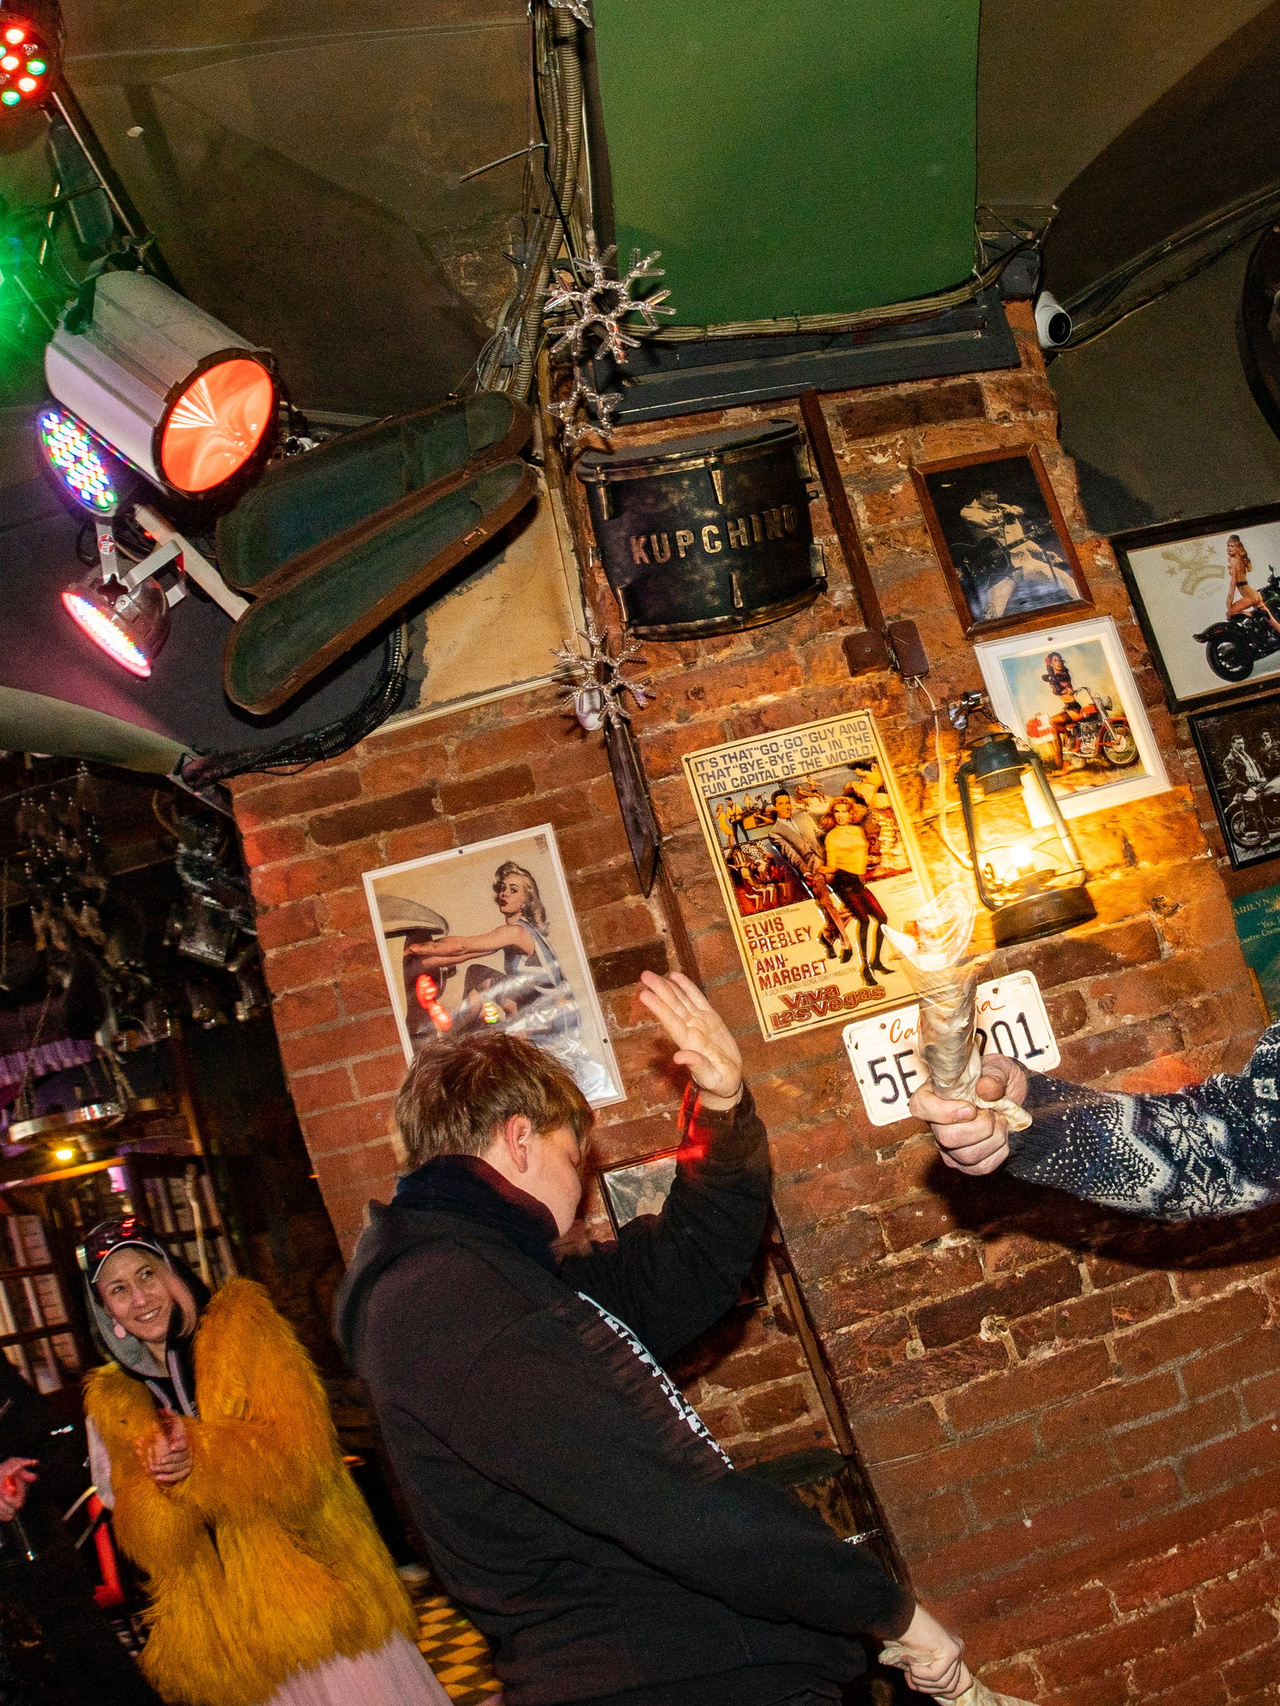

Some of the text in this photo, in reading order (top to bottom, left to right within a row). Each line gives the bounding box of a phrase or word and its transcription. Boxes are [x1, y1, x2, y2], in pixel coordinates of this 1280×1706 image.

[630, 504, 797, 565] KUPCHINO
[695, 720, 867, 772] IT'S THAT "GO-GO" GUY AND
[698, 732, 870, 783] THAT "BYE-BYE" GAL IN THE
[702, 745, 875, 796] FUN CAPITAL OF THE WORLD!
[742, 916, 784, 939] ELVIS
[747, 925, 812, 955] PRESLEY
[758, 958, 827, 990] MARGRET
[779, 984, 840, 1009] Viva
